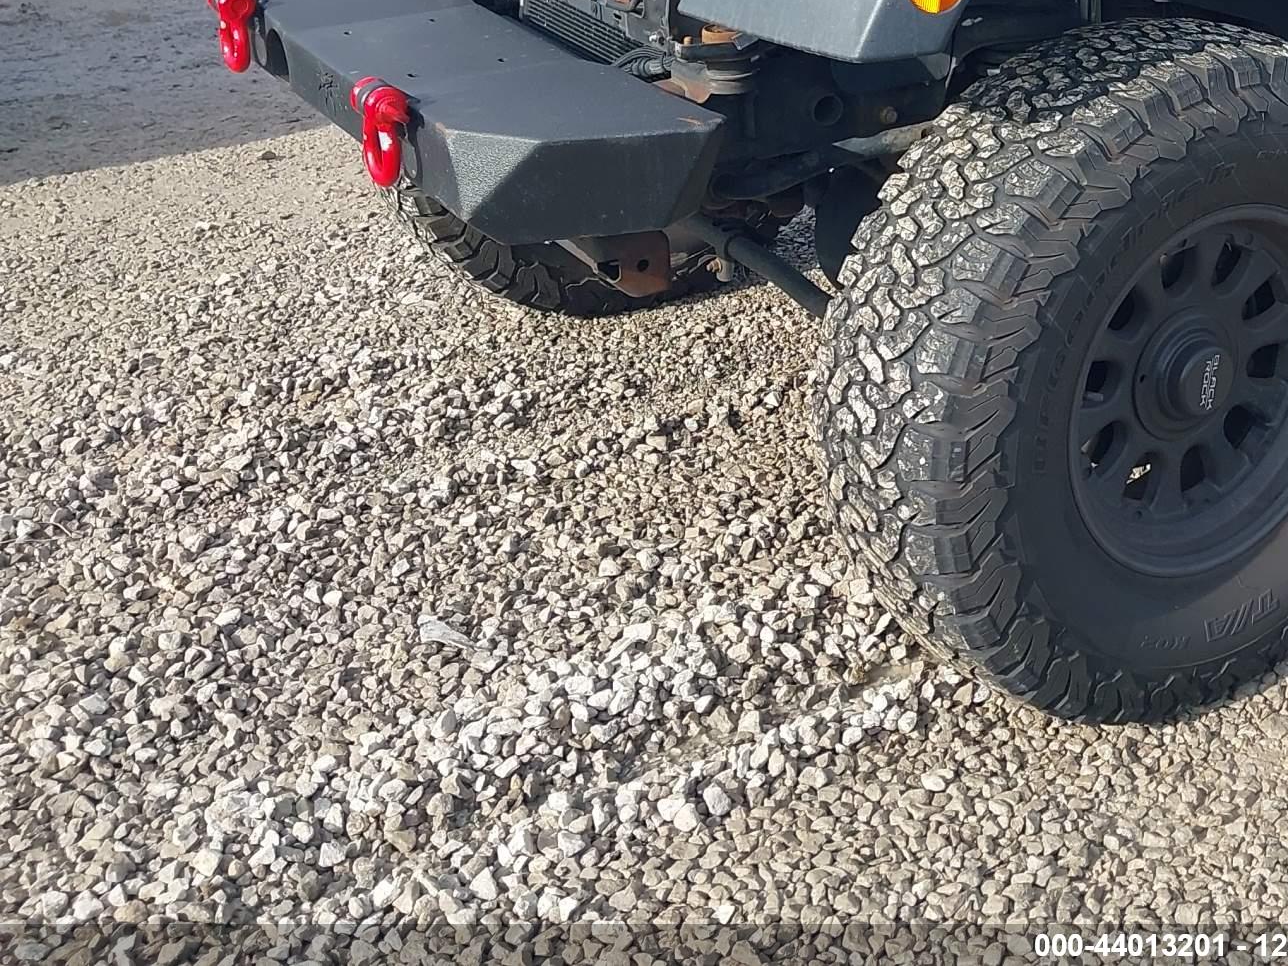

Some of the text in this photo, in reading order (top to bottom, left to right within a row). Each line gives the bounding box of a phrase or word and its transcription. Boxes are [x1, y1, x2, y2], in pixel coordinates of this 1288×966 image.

[1199, 360, 1212, 407] ROCK
[1206, 354, 1221, 411] BLACK
[1202, 586, 1281, 643] T/A
